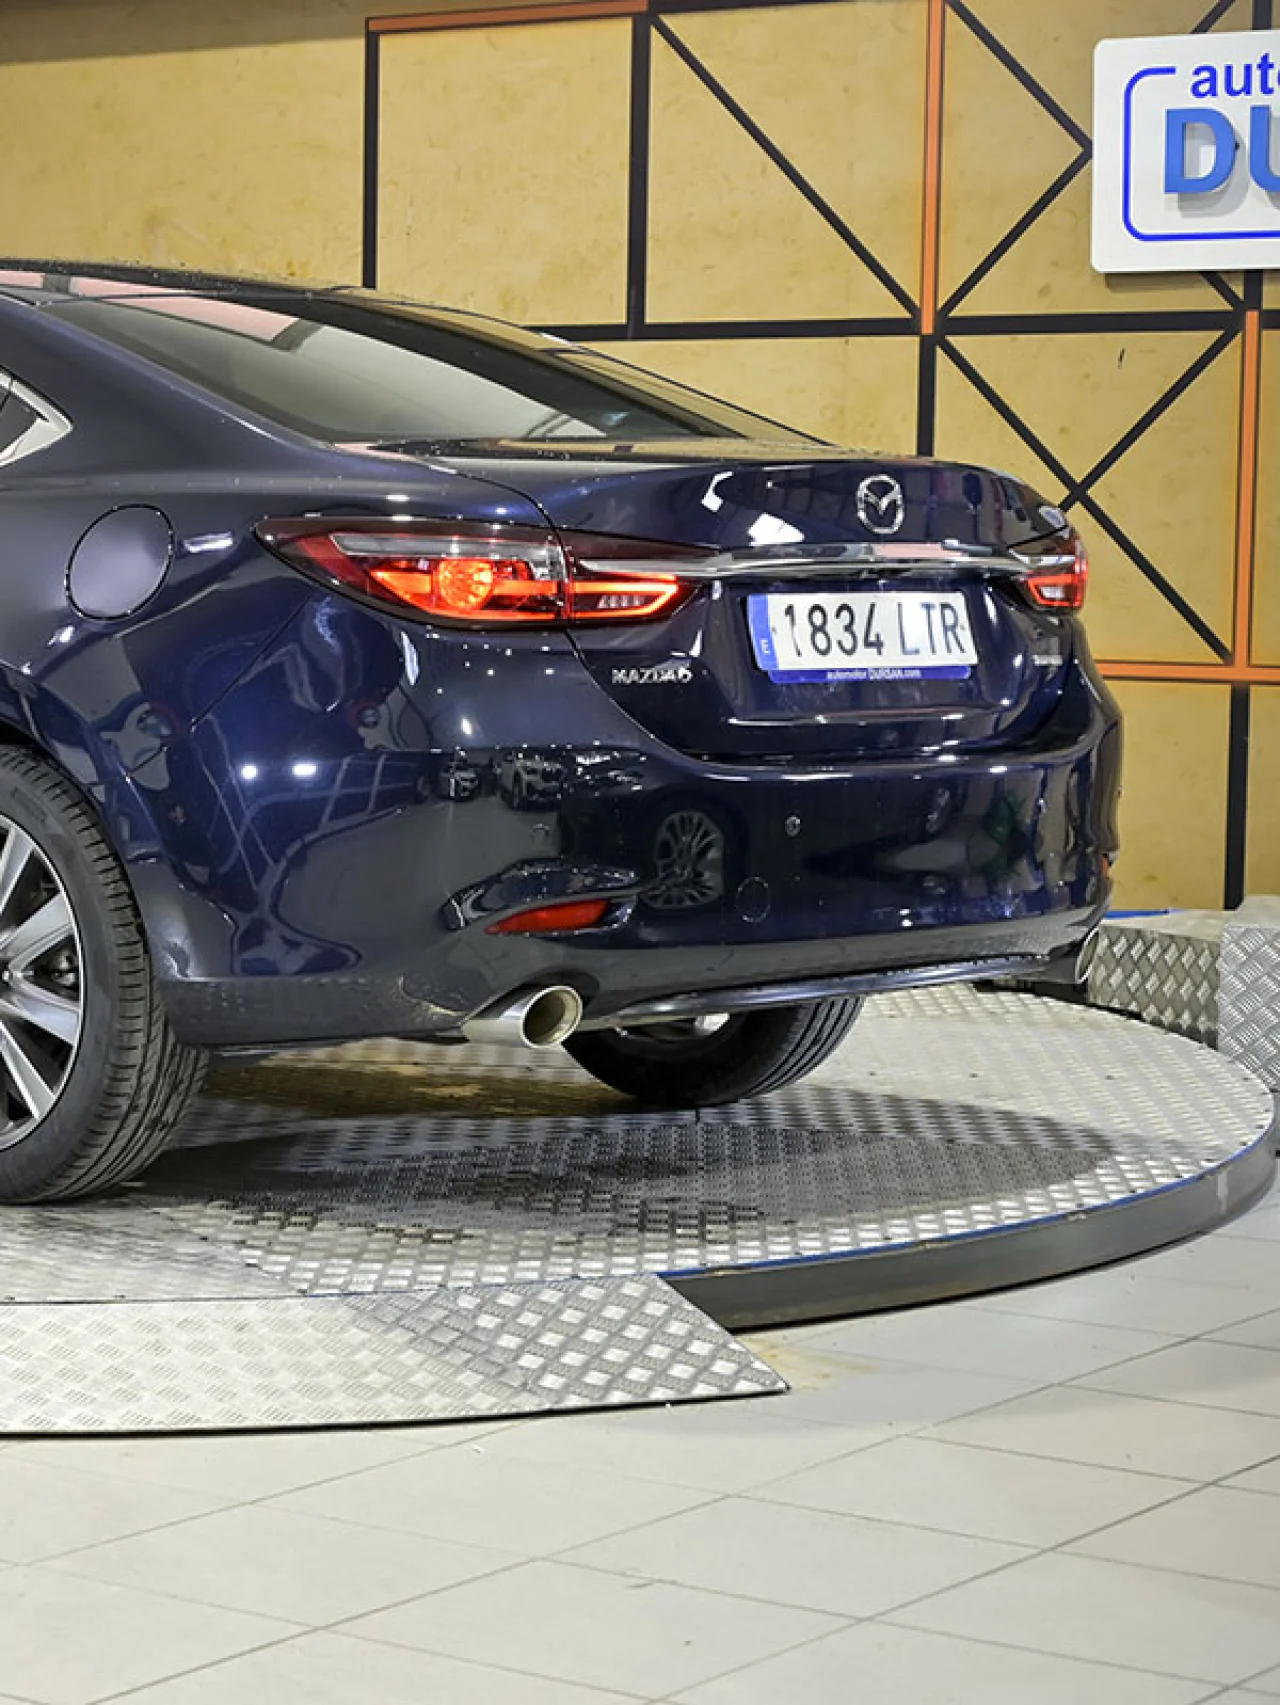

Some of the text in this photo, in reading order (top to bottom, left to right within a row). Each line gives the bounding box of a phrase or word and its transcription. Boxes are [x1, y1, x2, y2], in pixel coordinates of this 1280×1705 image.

[1190, 52, 1280, 98] aut
[784, 602, 967, 657] 1834 LTR
